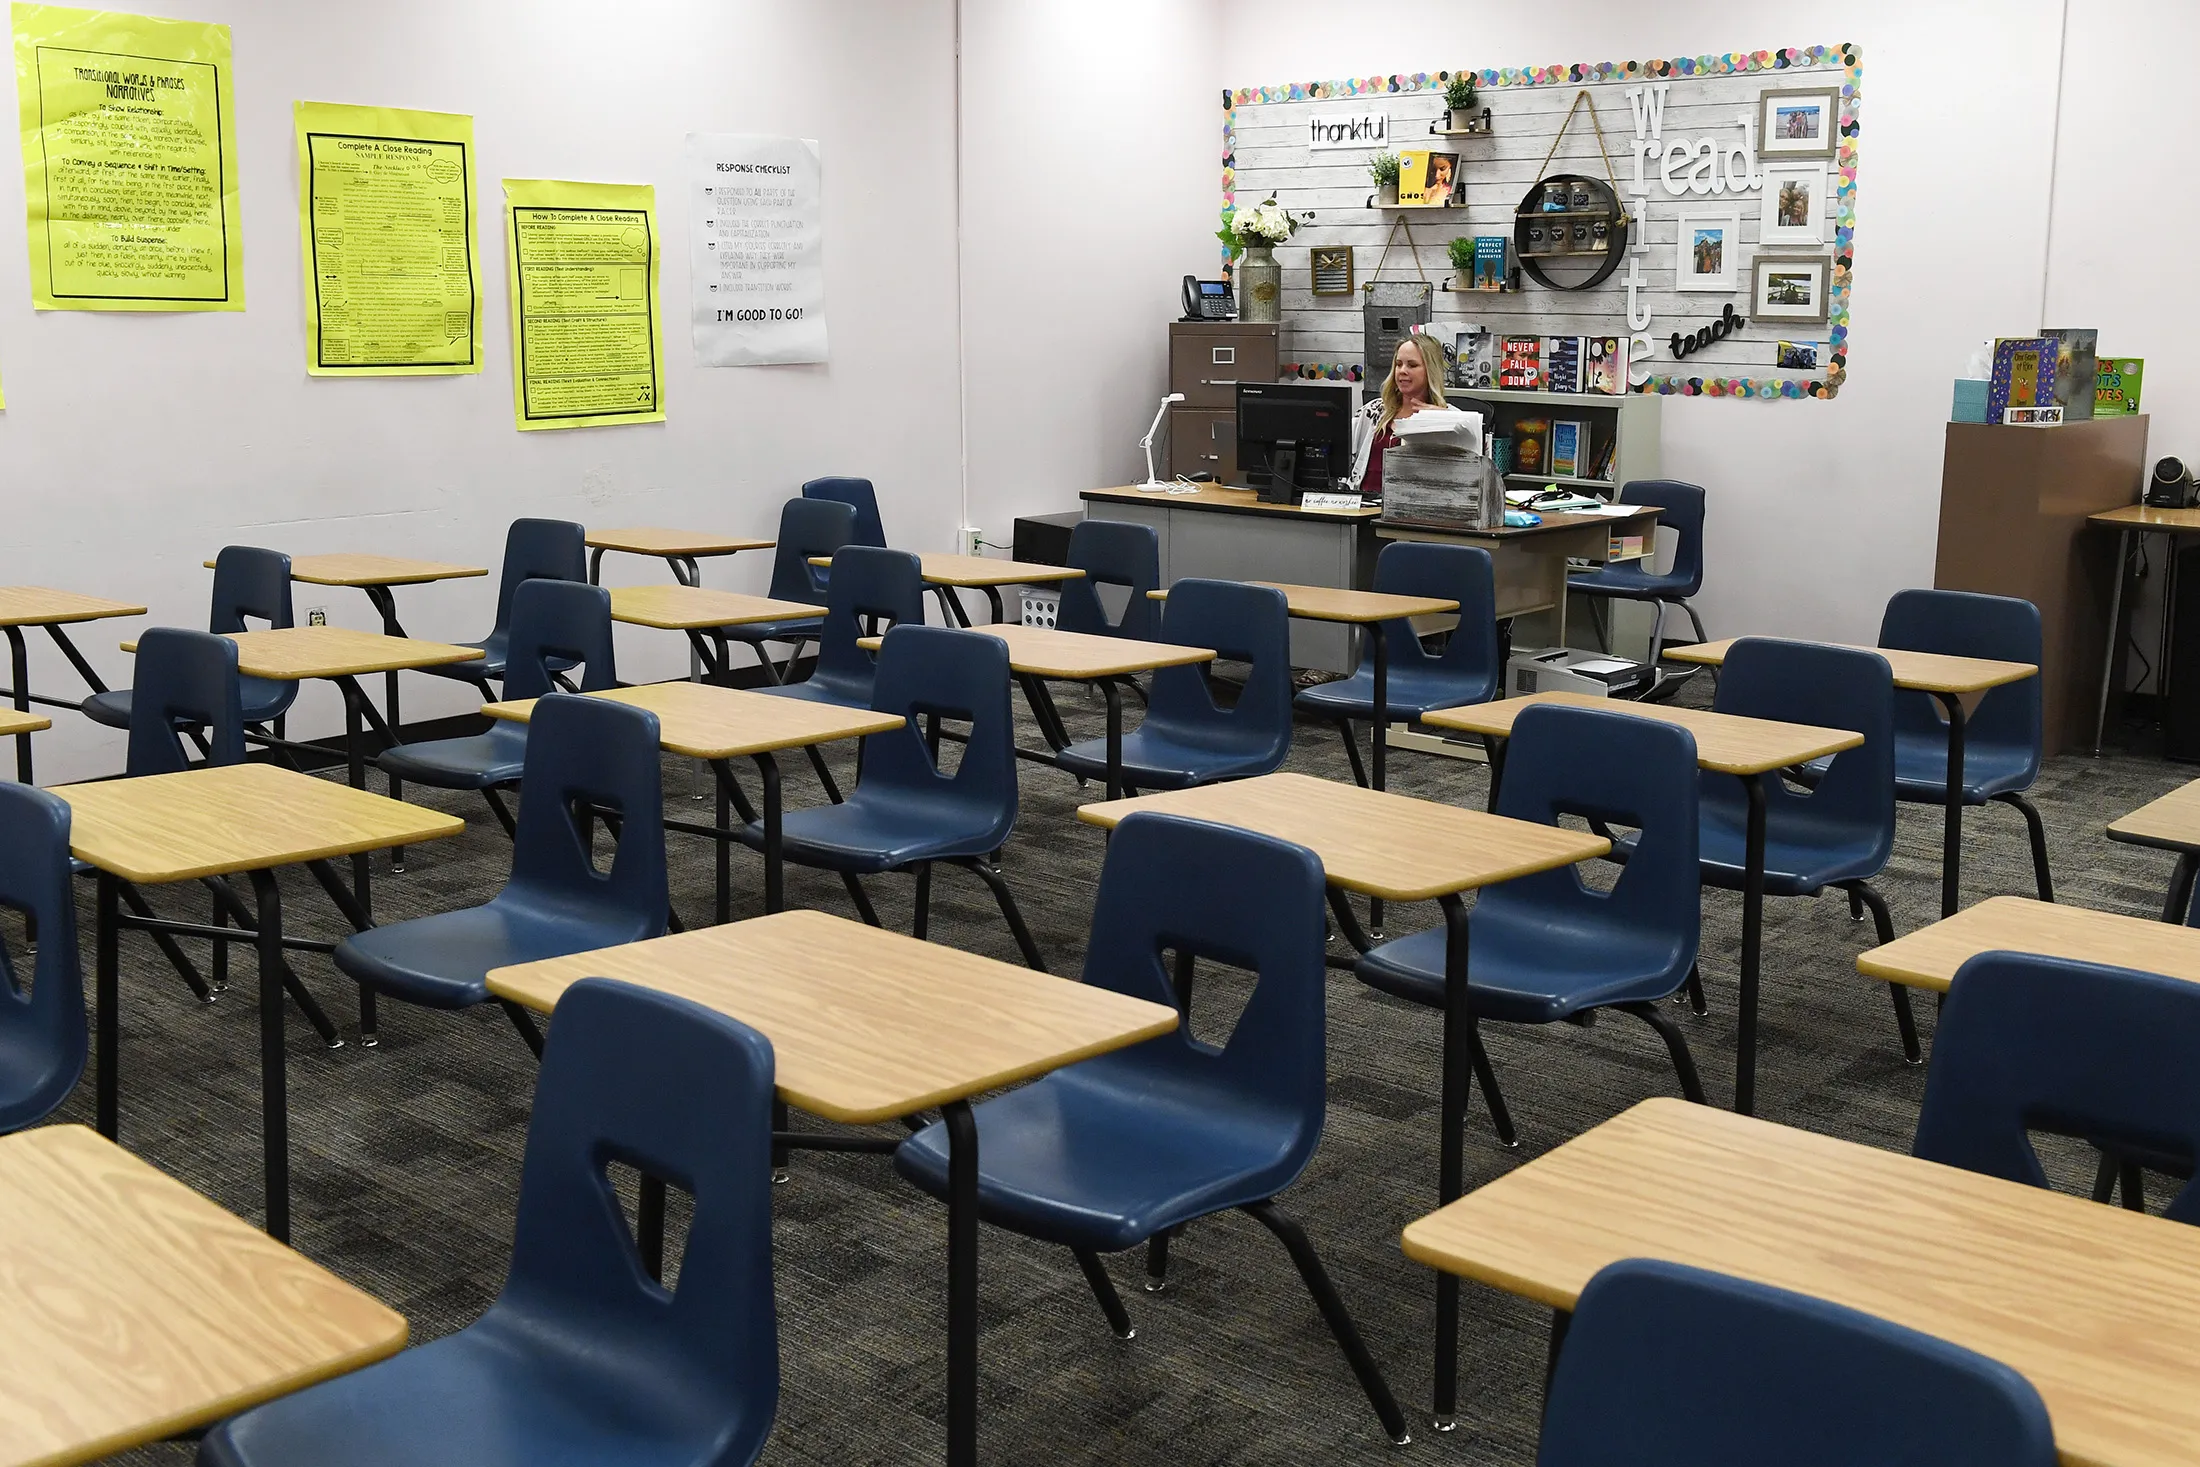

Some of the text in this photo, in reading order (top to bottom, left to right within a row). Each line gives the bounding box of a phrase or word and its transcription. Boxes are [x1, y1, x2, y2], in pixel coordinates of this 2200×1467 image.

[1311, 116, 1384, 144] thankful
[338, 141, 372, 151] Complete
[382, 144, 402, 153] Close
[403, 145, 433, 156] Reading
[355, 152, 420, 162] SAMPLE RESPONSE
[72, 158, 96, 168] Convey
[104, 160, 136, 169] Sequence
[143, 163, 158, 171] Shift
[716, 163, 791, 174] RESPONSE CHECKLIST
[558, 213, 588, 221] Complete
[615, 214, 639, 223] Reading
[120, 234, 135, 243] Build
[136, 235, 167, 244] Suspense:
[717, 308, 803, 321] I'M GOOD TO GO!
[1668, 303, 1746, 359] teach
[1507, 342, 1534, 352] NEVER
[1510, 359, 1529, 369] FALL
[1508, 375, 1531, 386] DOWN
[1554, 383, 1568, 391] Diary
[2010, 409, 2061, 423] LIBRARY
